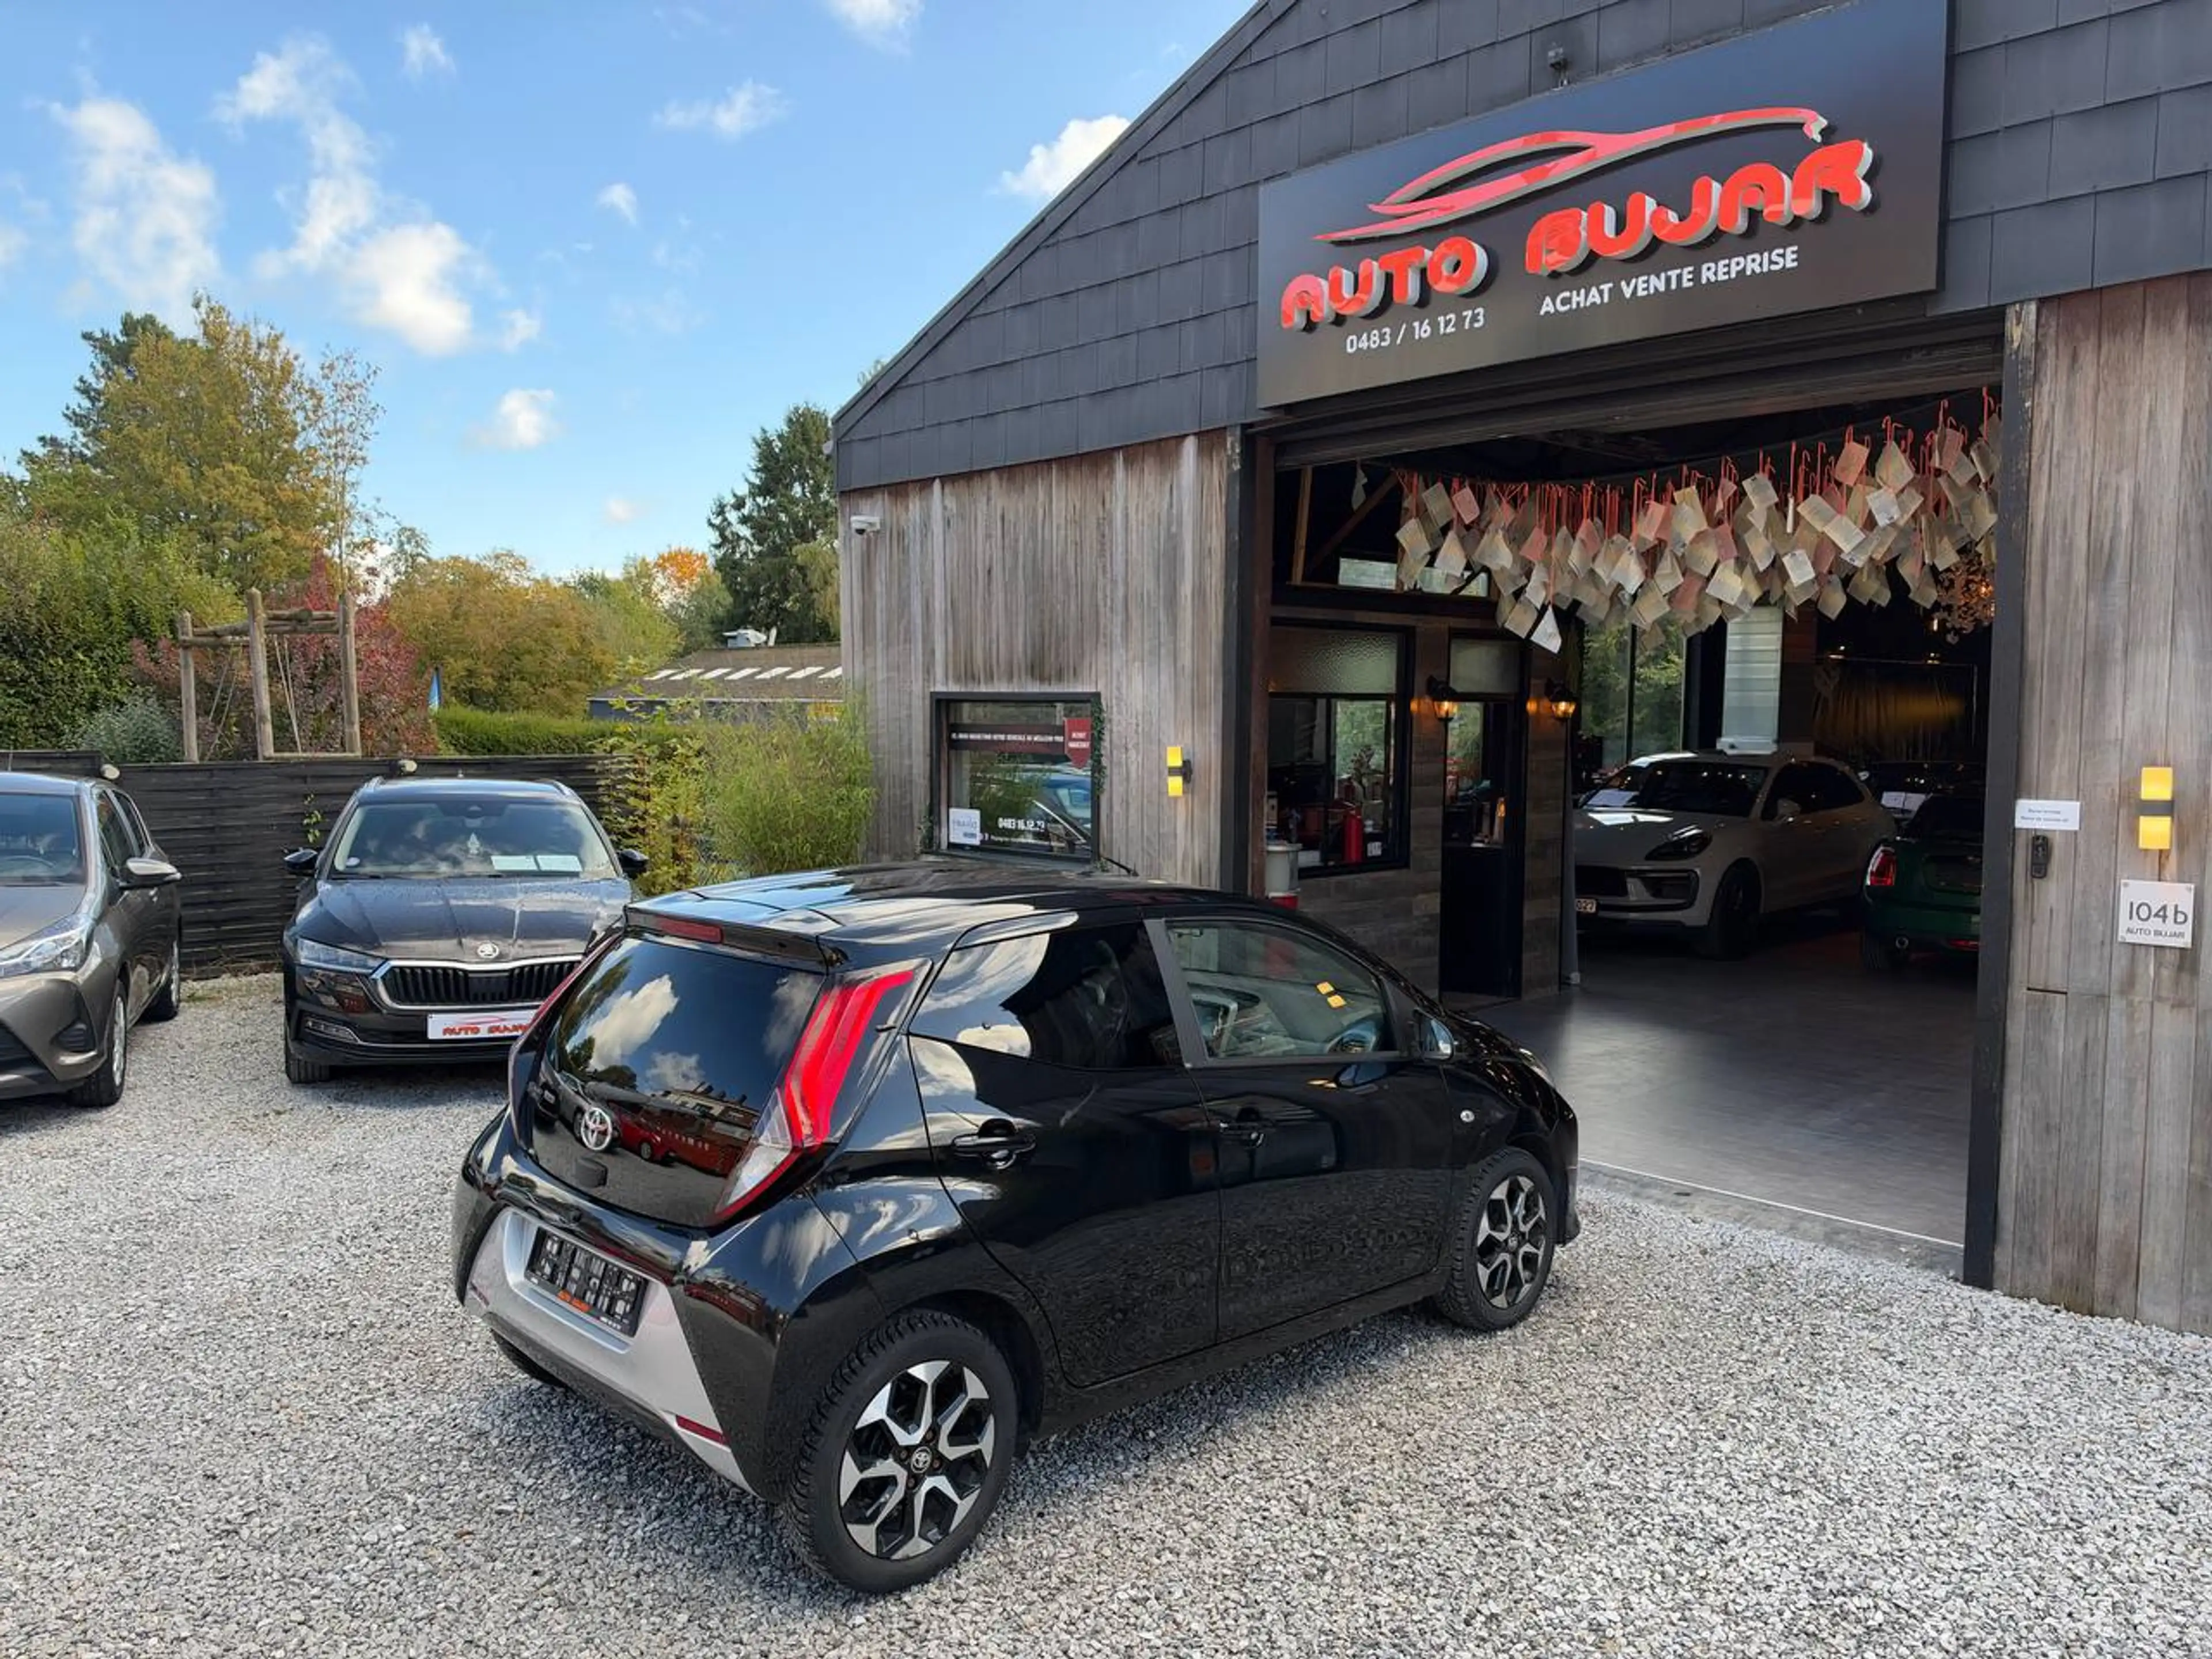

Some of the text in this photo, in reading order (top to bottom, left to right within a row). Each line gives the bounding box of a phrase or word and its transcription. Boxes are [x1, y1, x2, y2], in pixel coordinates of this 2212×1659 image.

[1281, 139, 1874, 329] AUTO BUJAR
[1540, 245, 1798, 316] ACHAT VENTE REPRISE
[1346, 326, 1391, 354] 0483
[1412, 318, 1431, 340] 16
[1437, 313, 1456, 335] 12
[1461, 306, 1485, 330] 73
[2126, 926, 2152, 937] AUTO
[442, 1025, 480, 1036] AUTO
